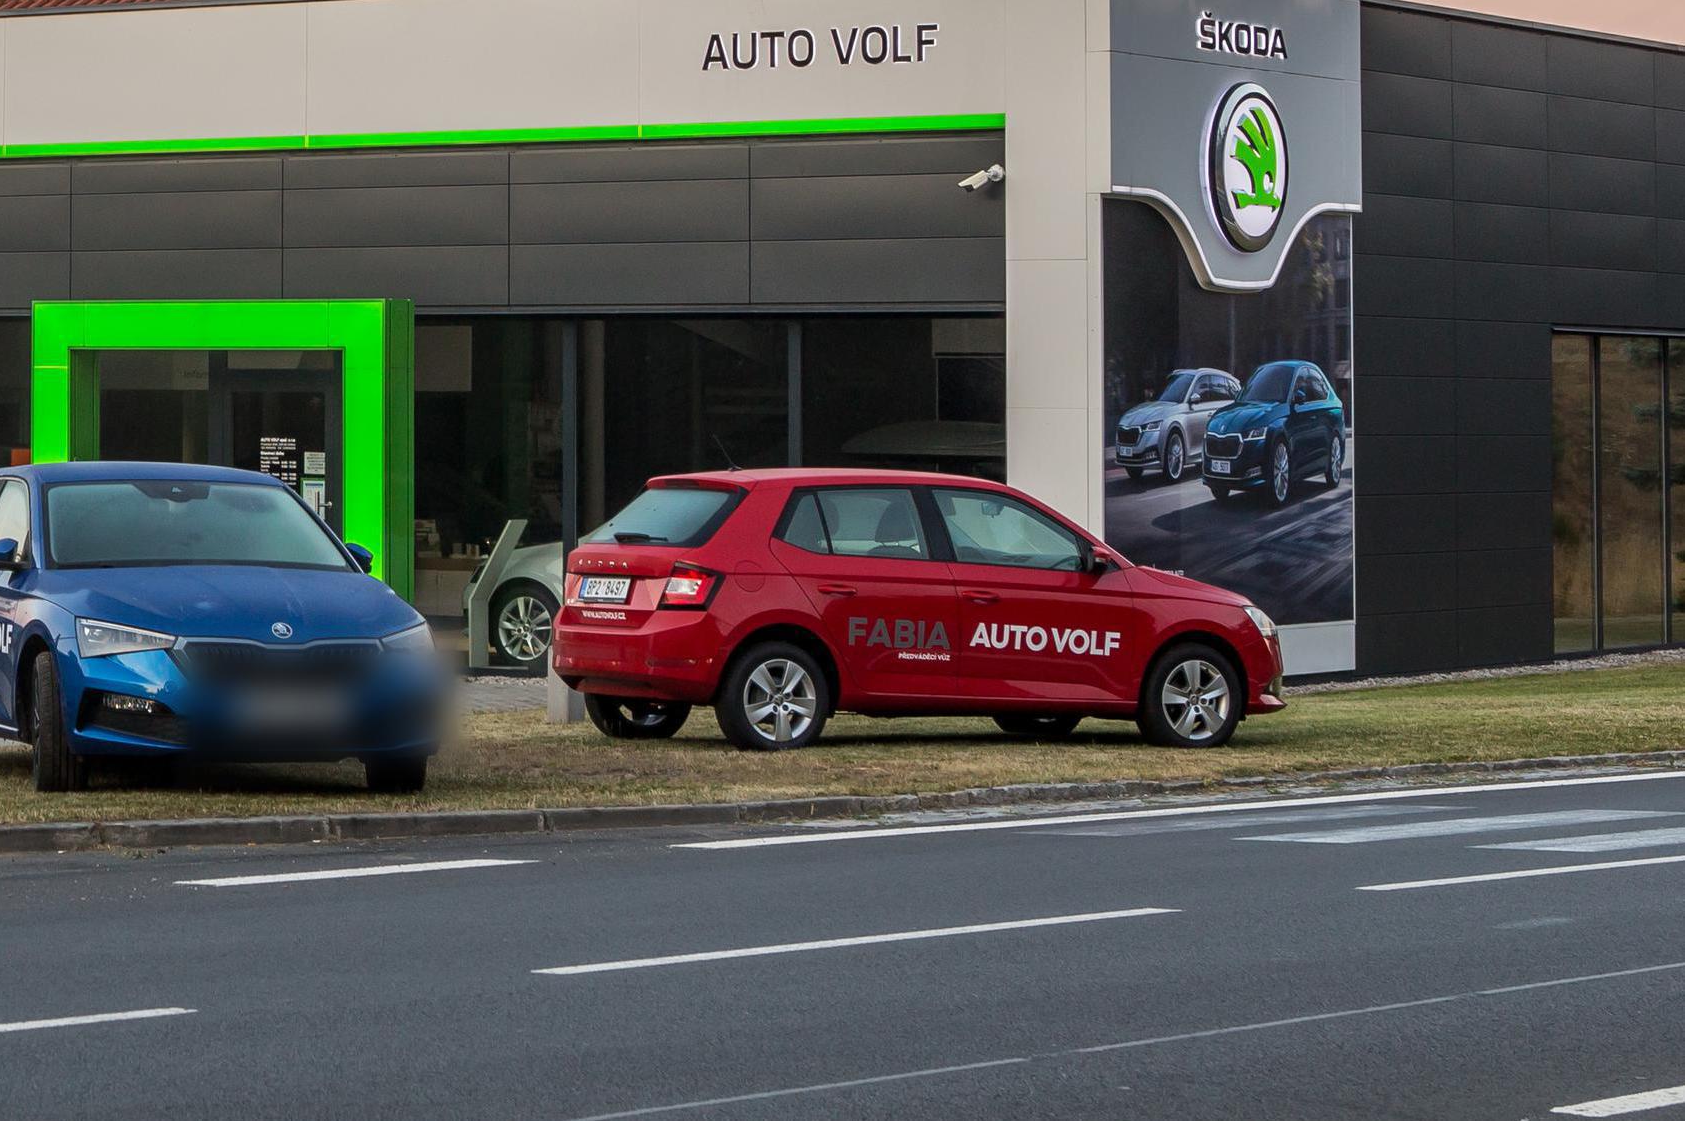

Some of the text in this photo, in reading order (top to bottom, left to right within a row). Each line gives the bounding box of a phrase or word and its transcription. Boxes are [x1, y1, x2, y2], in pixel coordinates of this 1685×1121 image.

[702, 24, 938, 71] AUTO VOLF
[1197, 11, 1288, 60] ŠKODA
[848, 616, 951, 649] FABIA
[969, 622, 1121, 656] AUTO VOLF
